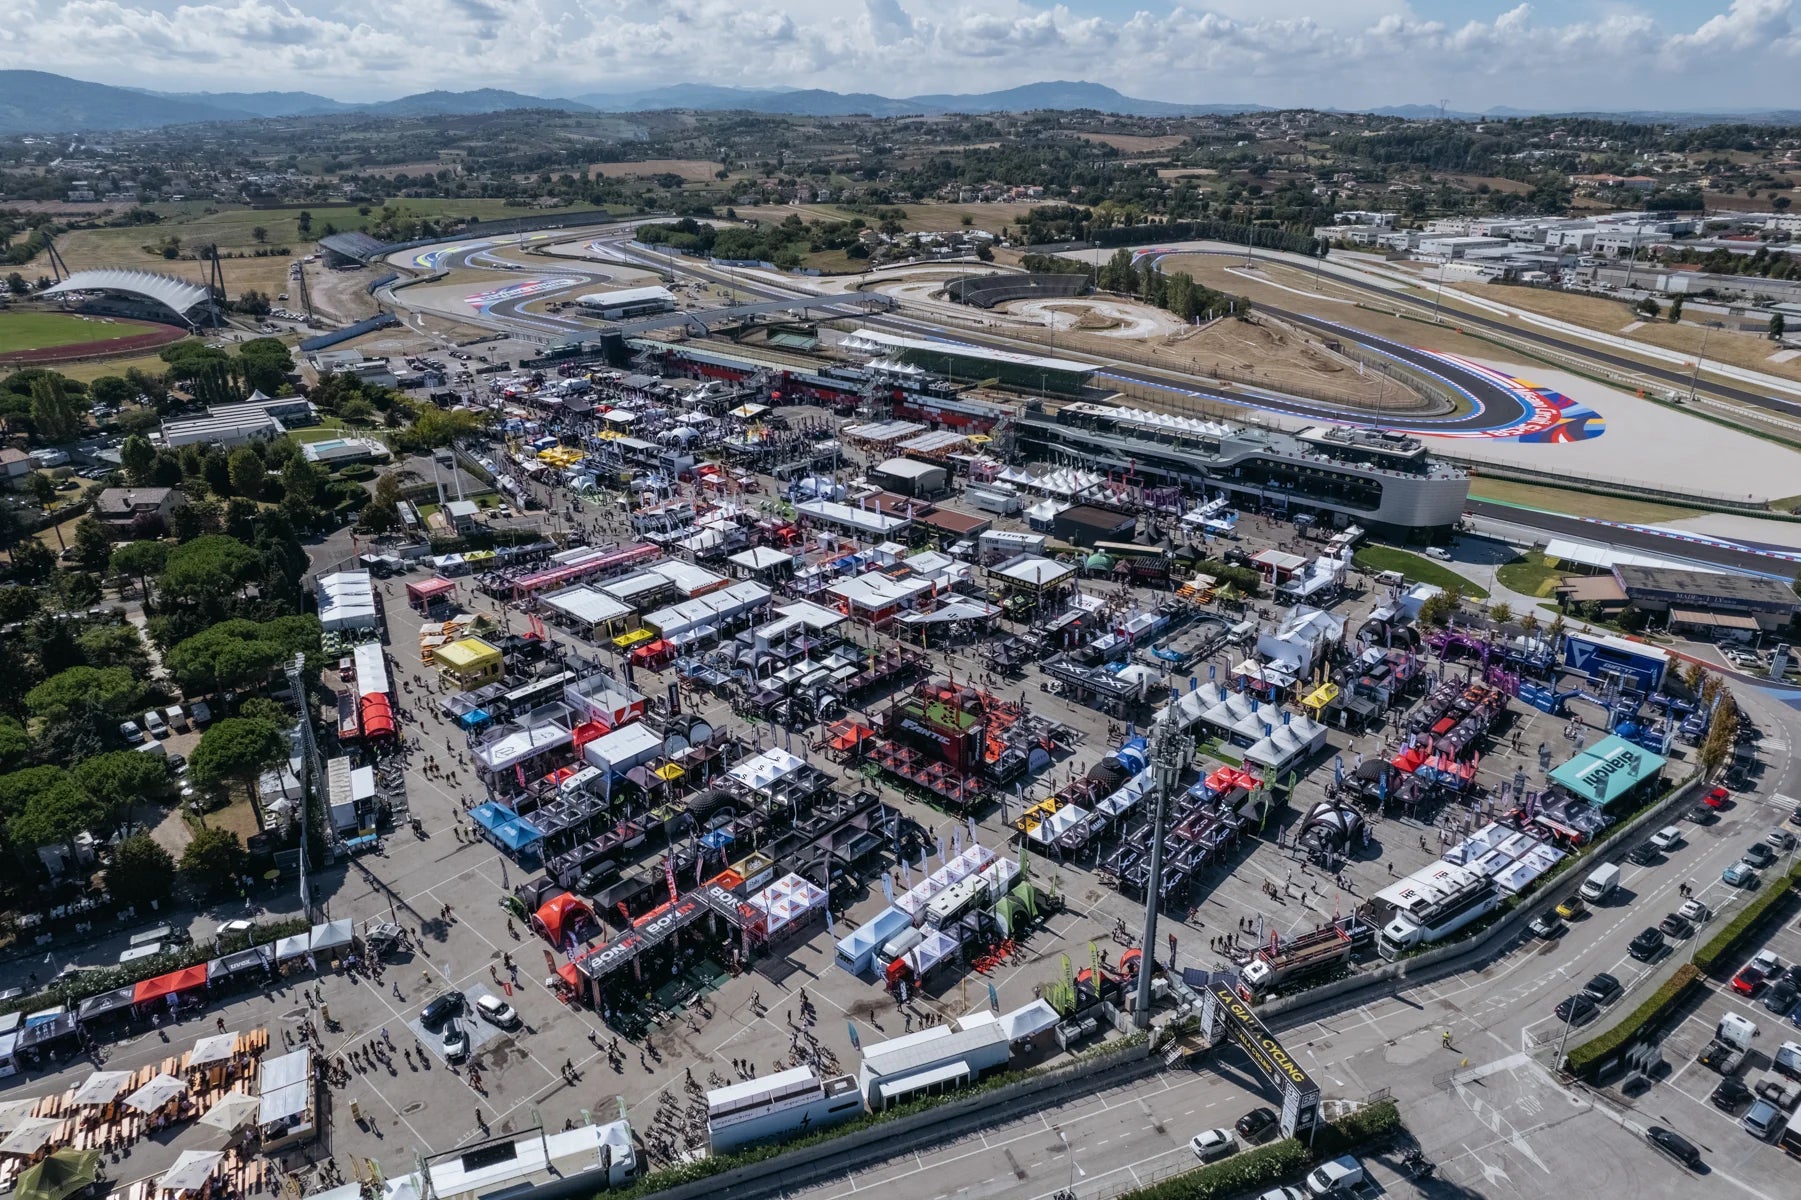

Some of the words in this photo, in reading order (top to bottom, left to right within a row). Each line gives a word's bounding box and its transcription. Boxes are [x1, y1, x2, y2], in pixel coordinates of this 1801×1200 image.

[901, 718, 950, 746] FANTIC
[1582, 750, 1634, 789] Bianchi
[646, 902, 696, 933] BONIN
[710, 887, 756, 918] BONIN
[230, 959, 251, 970] uvex
[1217, 990, 1232, 1004] LA
[1262, 1039, 1305, 1082] CYCLING
[1251, 1047, 1274, 1072] CYCLING
